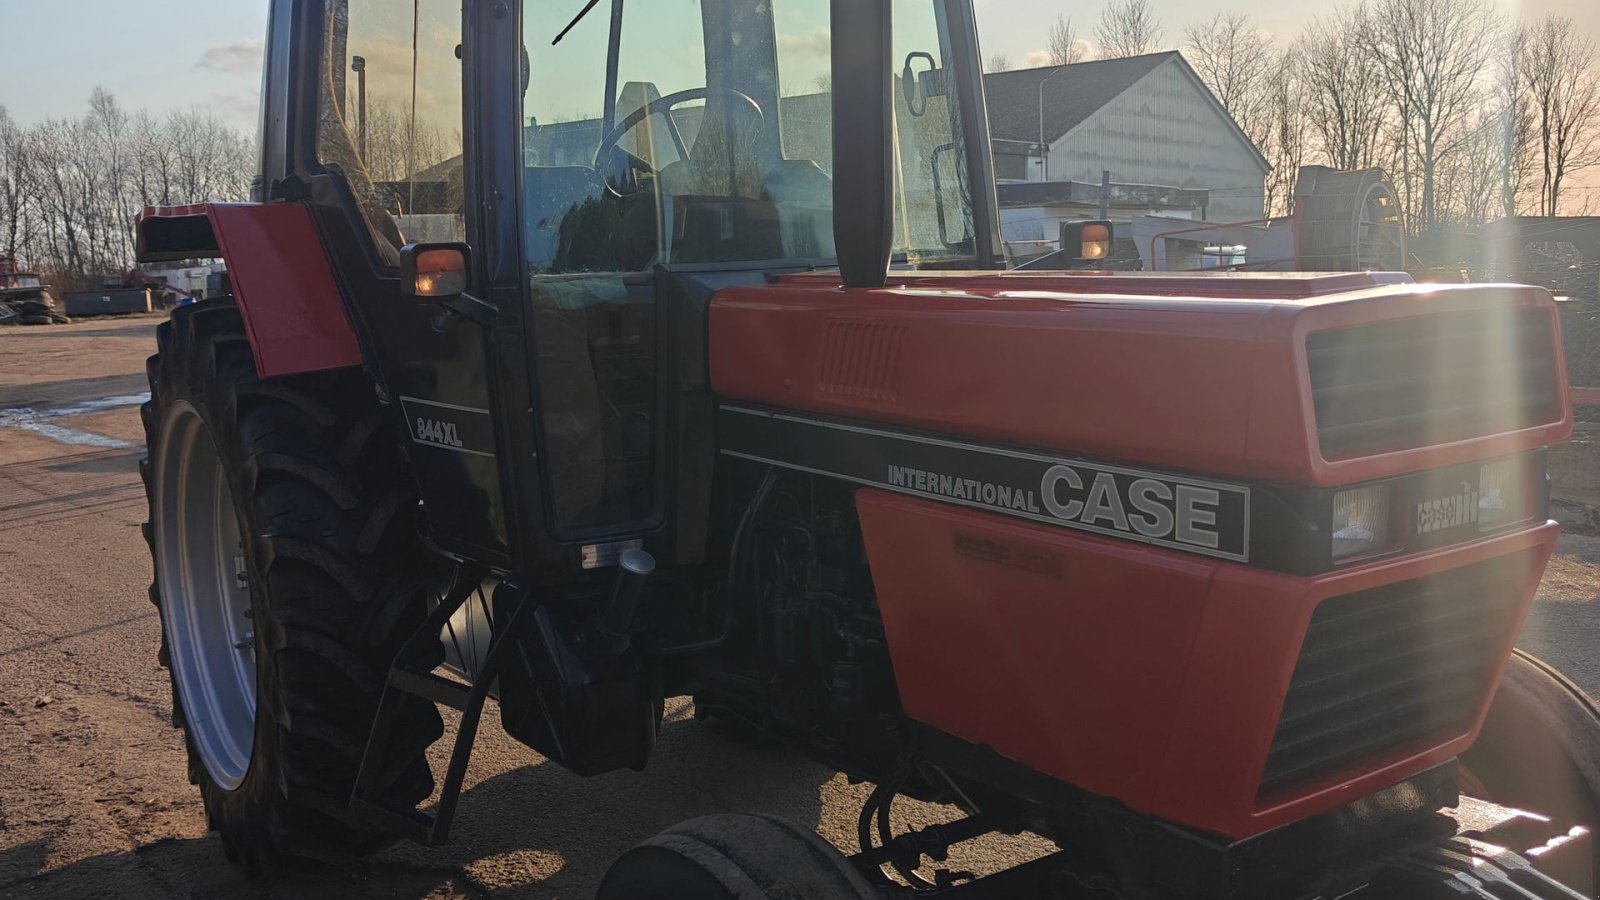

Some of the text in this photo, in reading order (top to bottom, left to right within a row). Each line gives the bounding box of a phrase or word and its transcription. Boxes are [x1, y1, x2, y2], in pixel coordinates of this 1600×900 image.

[416, 417, 463, 447] 844XL
[887, 464, 1220, 549] INTERNATIONAL CASE
